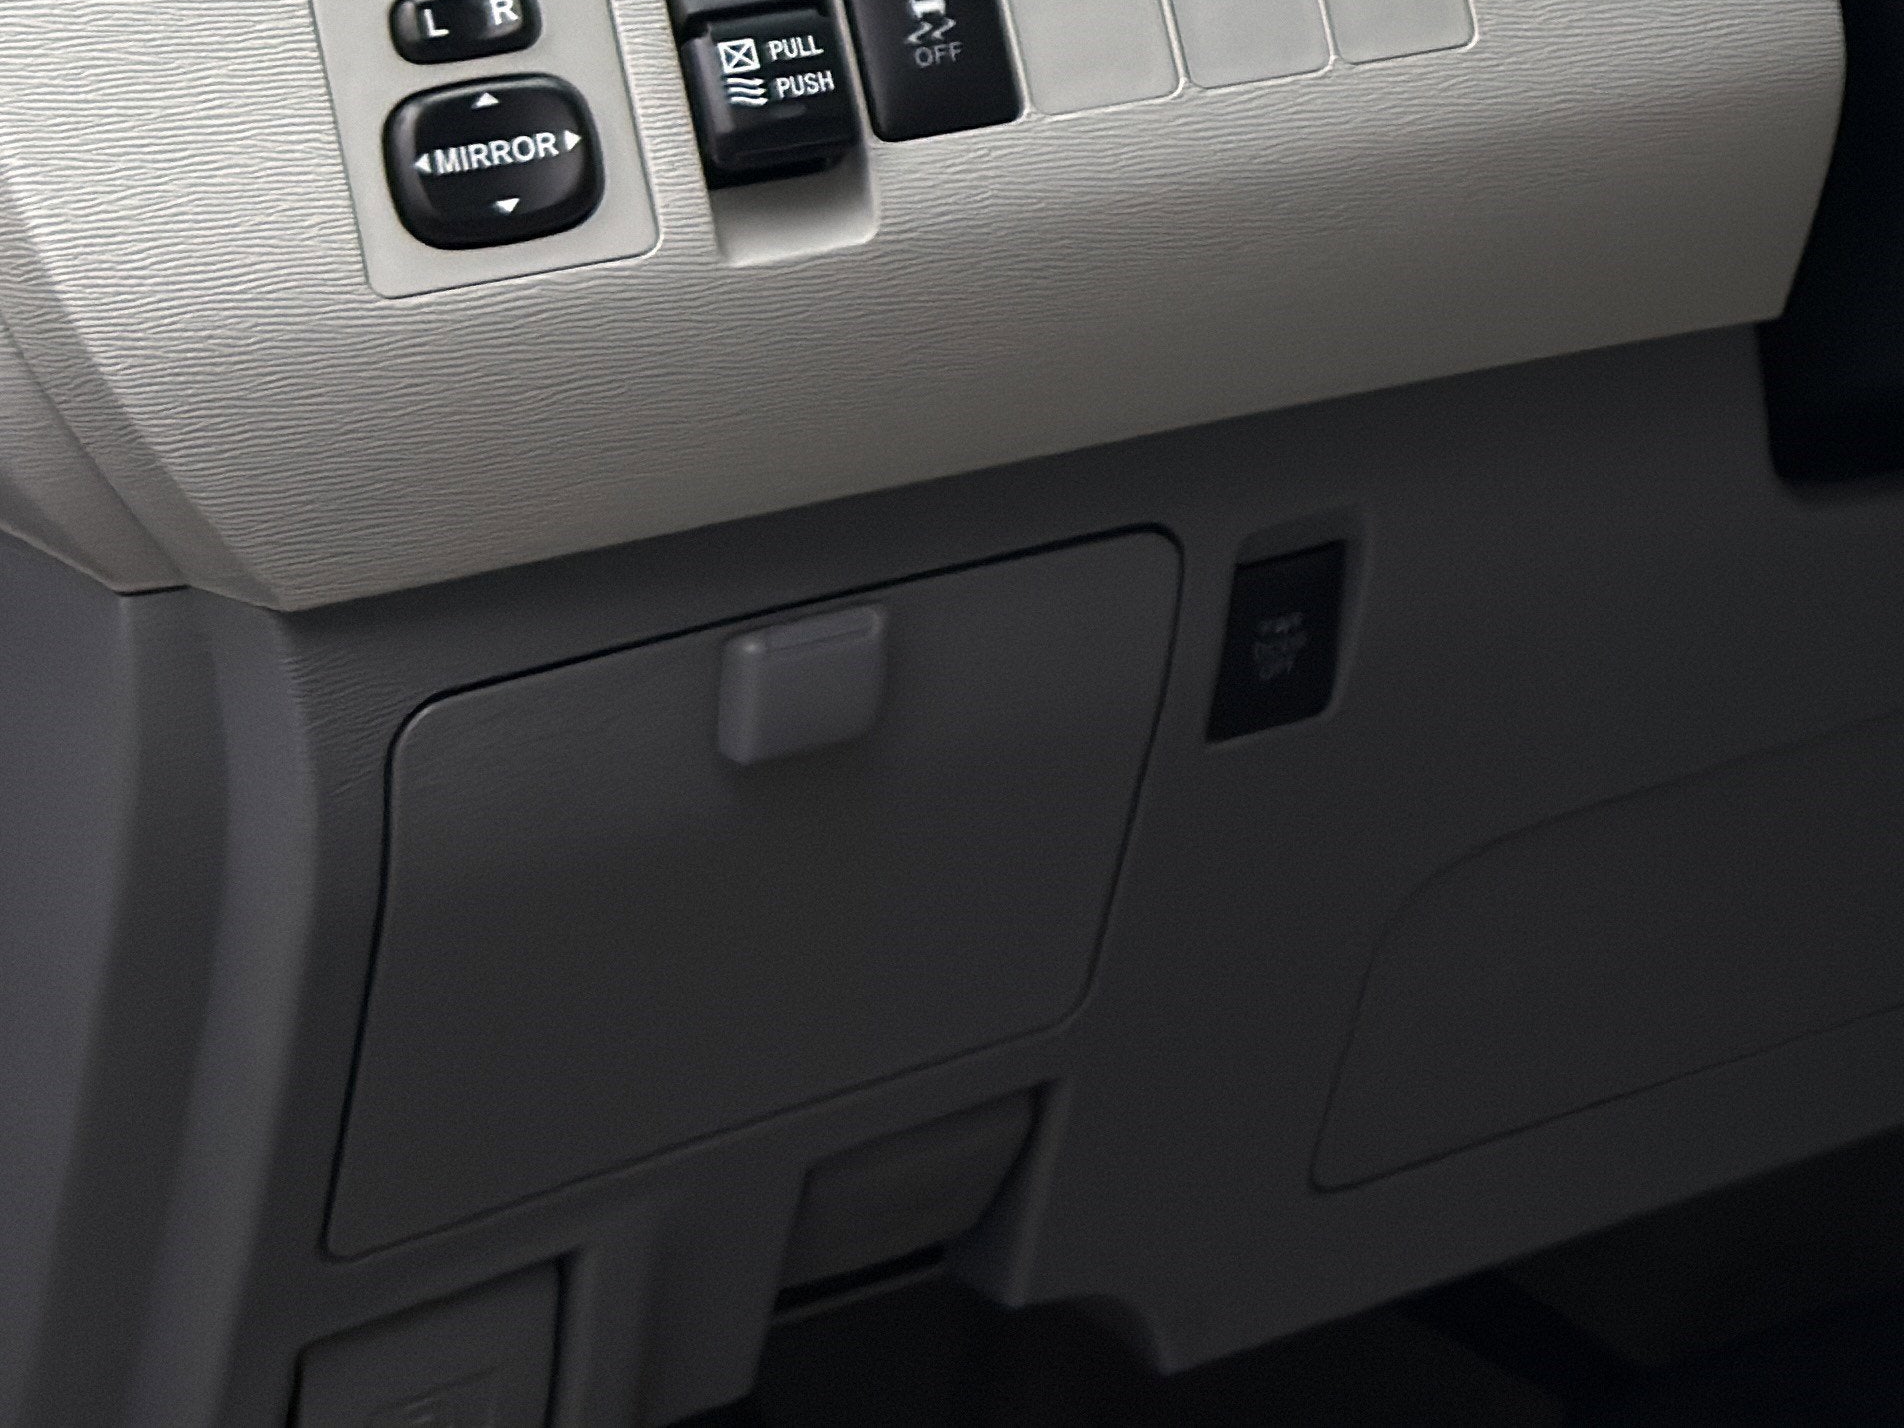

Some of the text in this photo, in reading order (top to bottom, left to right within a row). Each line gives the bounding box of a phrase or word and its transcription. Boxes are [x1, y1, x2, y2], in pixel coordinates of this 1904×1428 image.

[425, 6, 448, 38] L
[768, 35, 825, 61] PULL
[914, 41, 963, 69] OFF
[775, 70, 835, 98] PUSH
[434, 132, 559, 176] MIRROR
